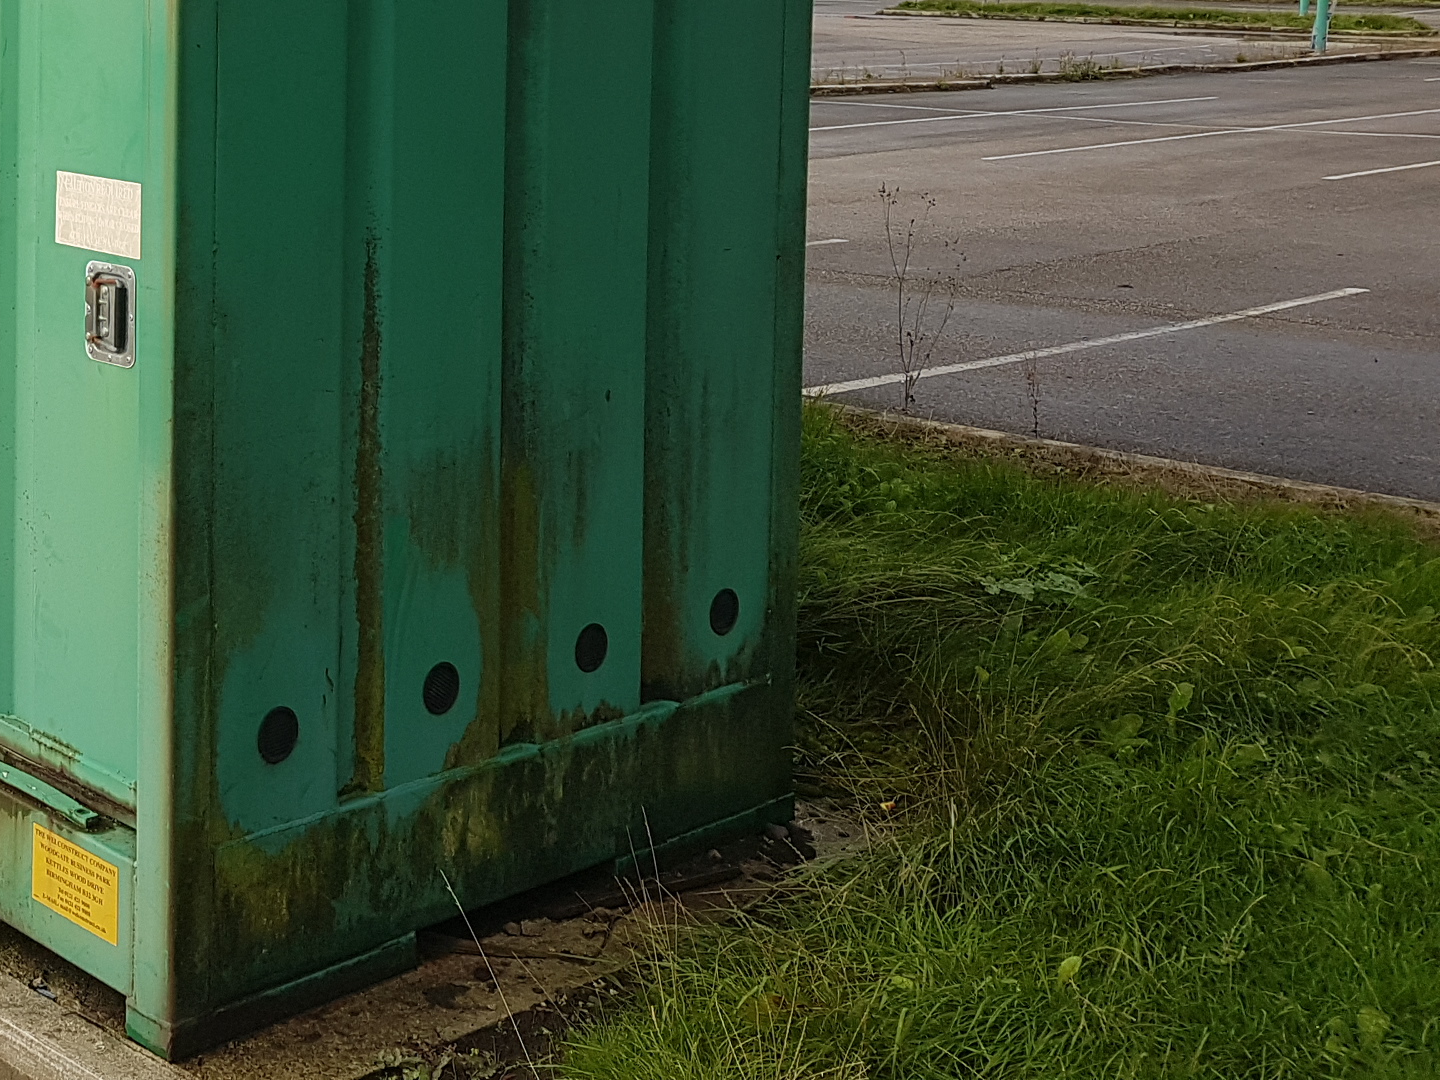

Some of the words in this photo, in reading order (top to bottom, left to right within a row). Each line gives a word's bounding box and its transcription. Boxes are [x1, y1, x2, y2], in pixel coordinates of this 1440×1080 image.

[35, 829, 45, 839] THE
[47, 835, 88, 863] WELCONSTRUCT
[89, 858, 116, 878] COMPANY
[40, 843, 69, 864] WOODGATE
[71, 859, 95, 878] BUSINESS
[46, 857, 69, 875] KETTLES
[70, 870, 86, 885] WOOD
[87, 880, 104, 895] DRIVE
[46, 869, 81, 894] BIRMINGHAM
